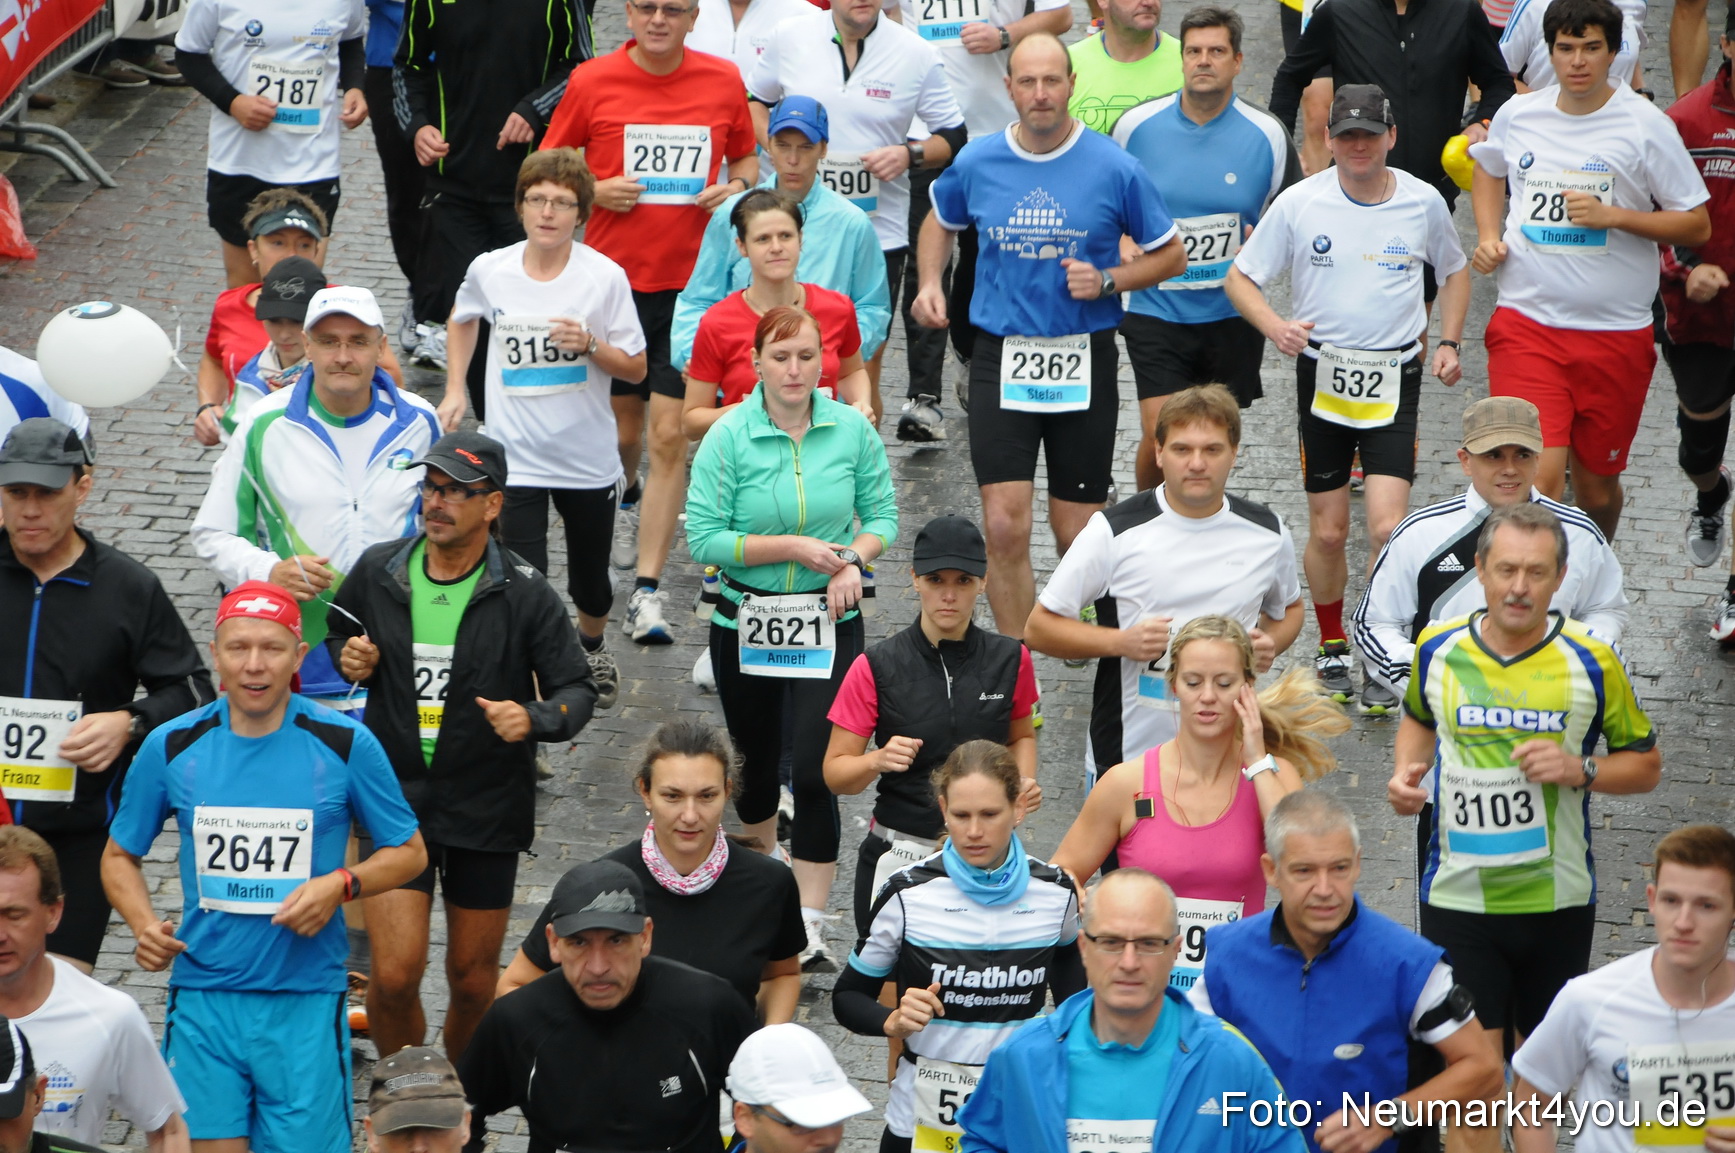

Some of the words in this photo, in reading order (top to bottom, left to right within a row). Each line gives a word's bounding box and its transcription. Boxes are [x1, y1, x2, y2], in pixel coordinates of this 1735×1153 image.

[251, 62, 277, 73] PARTL
[280, 65, 314, 75] Neumarkt
[256, 75, 318, 106] 2187
[274, 112, 302, 123] ubert
[626, 132, 654, 141] PARTL
[657, 133, 696, 142] Neumarkt
[633, 145, 702, 173] 2877
[646, 180, 690, 192] Joachim
[816, 170, 871, 195] 590
[1526, 179, 1554, 189] PARTL
[1556, 181, 1597, 192] Neumarkt
[1530, 192, 1602, 222] 28
[987, 226, 1010, 240] 13.
[1005, 227, 1050, 236] Neumarkter
[1052, 228, 1088, 238] Stadtlauf
[1186, 222, 1225, 234] Neumarkt
[1541, 229, 1586, 244] Thomas
[1184, 232, 1232, 262] 227
[1183, 268, 1218, 281] Stefan
[498, 324, 525, 333] PARTL
[1005, 339, 1032, 348] PARTL
[1034, 341, 1076, 350] Neumarkt
[1011, 350, 1082, 381] 2362
[1320, 350, 1345, 366] PARTL
[1346, 356, 1387, 368] Neumarkt
[1332, 366, 1384, 399] 532
[1027, 388, 1063, 401] Stefan
[742, 602, 768, 614] PARTL
[770, 604, 816, 614] Neumarkt
[746, 616, 822, 647] 2621
[767, 652, 806, 666] Annett
[12, 709, 63, 720] Neumarkt
[417, 712, 443, 726] eter
[1458, 704, 1569, 733] BOCK
[4, 724, 46, 760] 92
[2, 768, 40, 786] Franz
[1454, 790, 1534, 828] 3103
[198, 818, 234, 829] PARTL
[236, 819, 290, 830] Neumarkt
[206, 834, 300, 873] 2647
[890, 846, 917, 861] ARTL
[227, 882, 274, 900] Martin
[1178, 910, 1224, 922] eumarkt
[930, 962, 1046, 990] Triathlon
[1170, 970, 1197, 988] rinn
[944, 990, 1033, 1008] Regensburg
[1631, 1053, 1674, 1070] PARTL
[918, 1067, 956, 1085] PARTL
[1658, 1071, 1735, 1114] 535
[1067, 1133, 1104, 1144] PARTL
[1108, 1134, 1152, 1145] Neuma
